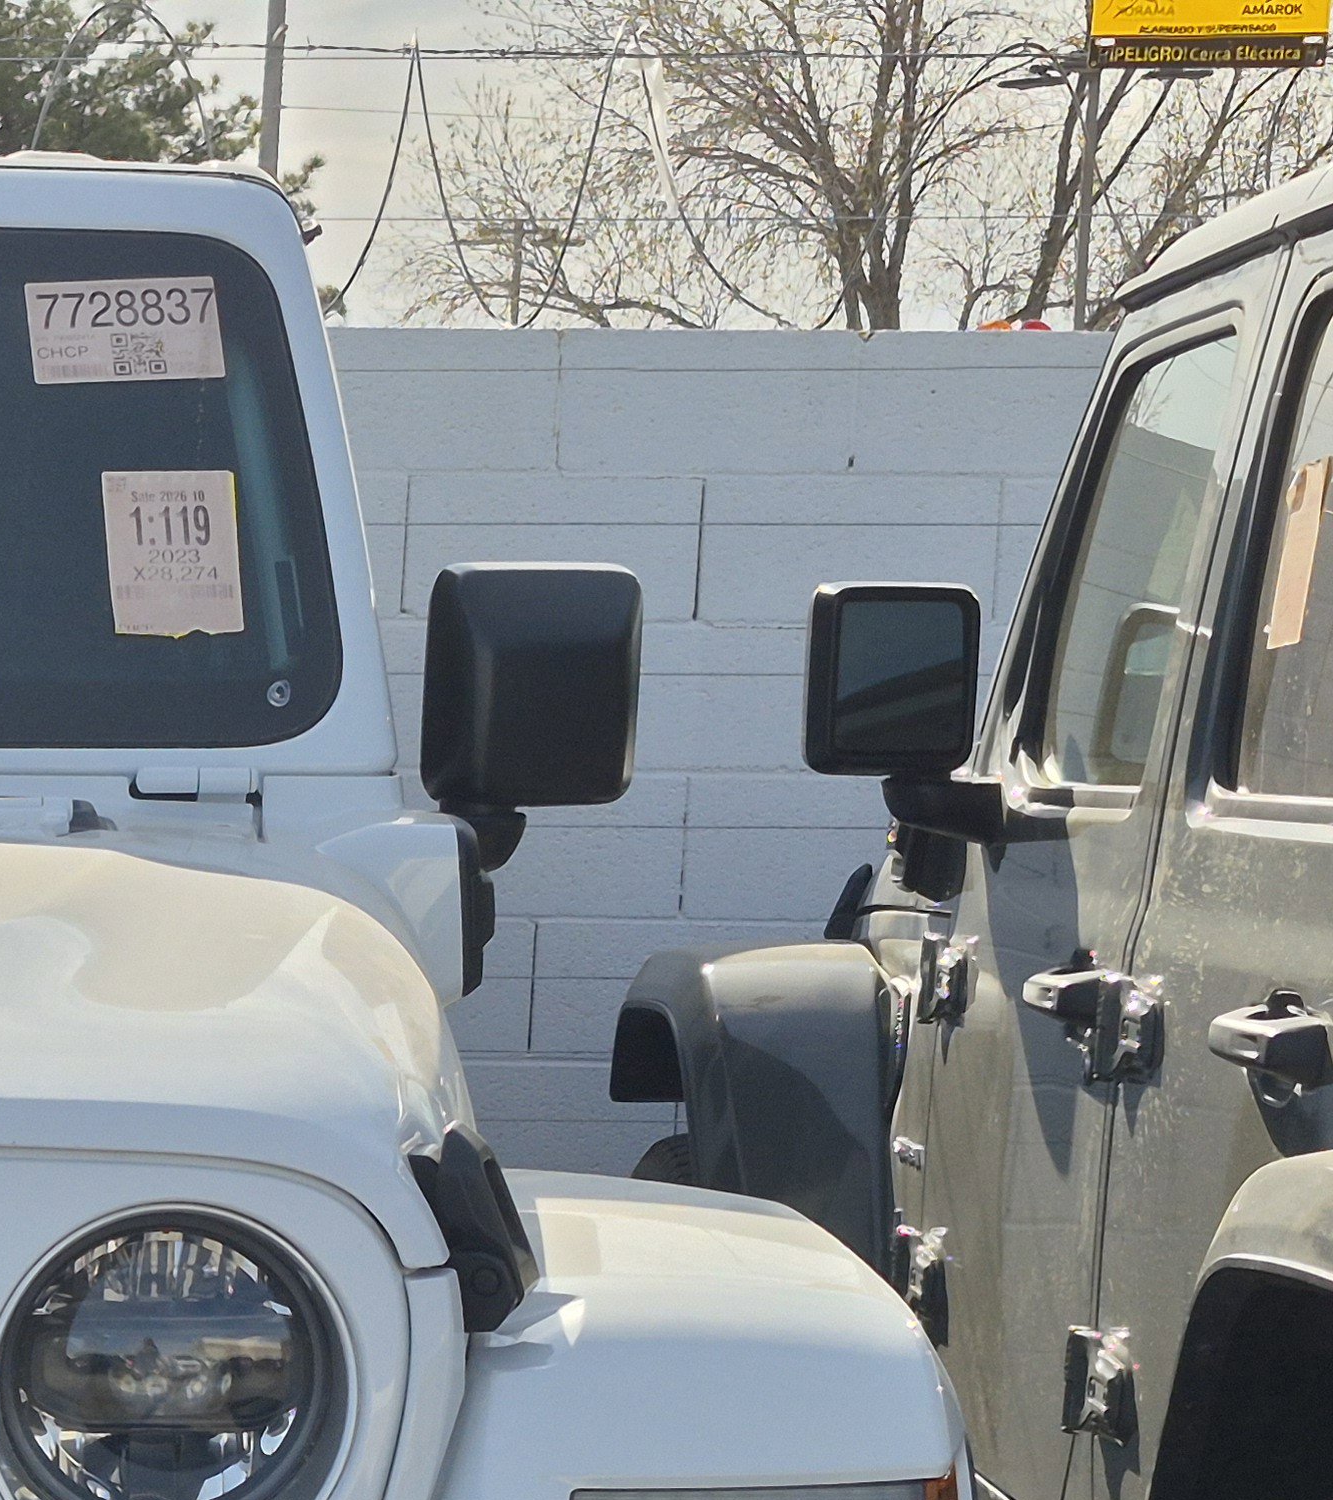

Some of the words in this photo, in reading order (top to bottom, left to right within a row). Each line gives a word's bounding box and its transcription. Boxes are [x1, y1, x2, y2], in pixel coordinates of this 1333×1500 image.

[1241, 3, 1303, 16] AMAROK
[1190, 46, 1231, 62] Cerca
[1236, 43, 1301, 61] Eléctrica
[35, 287, 214, 330] 7728837
[36, 345, 89, 360] CHCP
[128, 504, 212, 547] 1:119
[148, 550, 202, 565] 2023
[133, 566, 218, 583] X28,274
